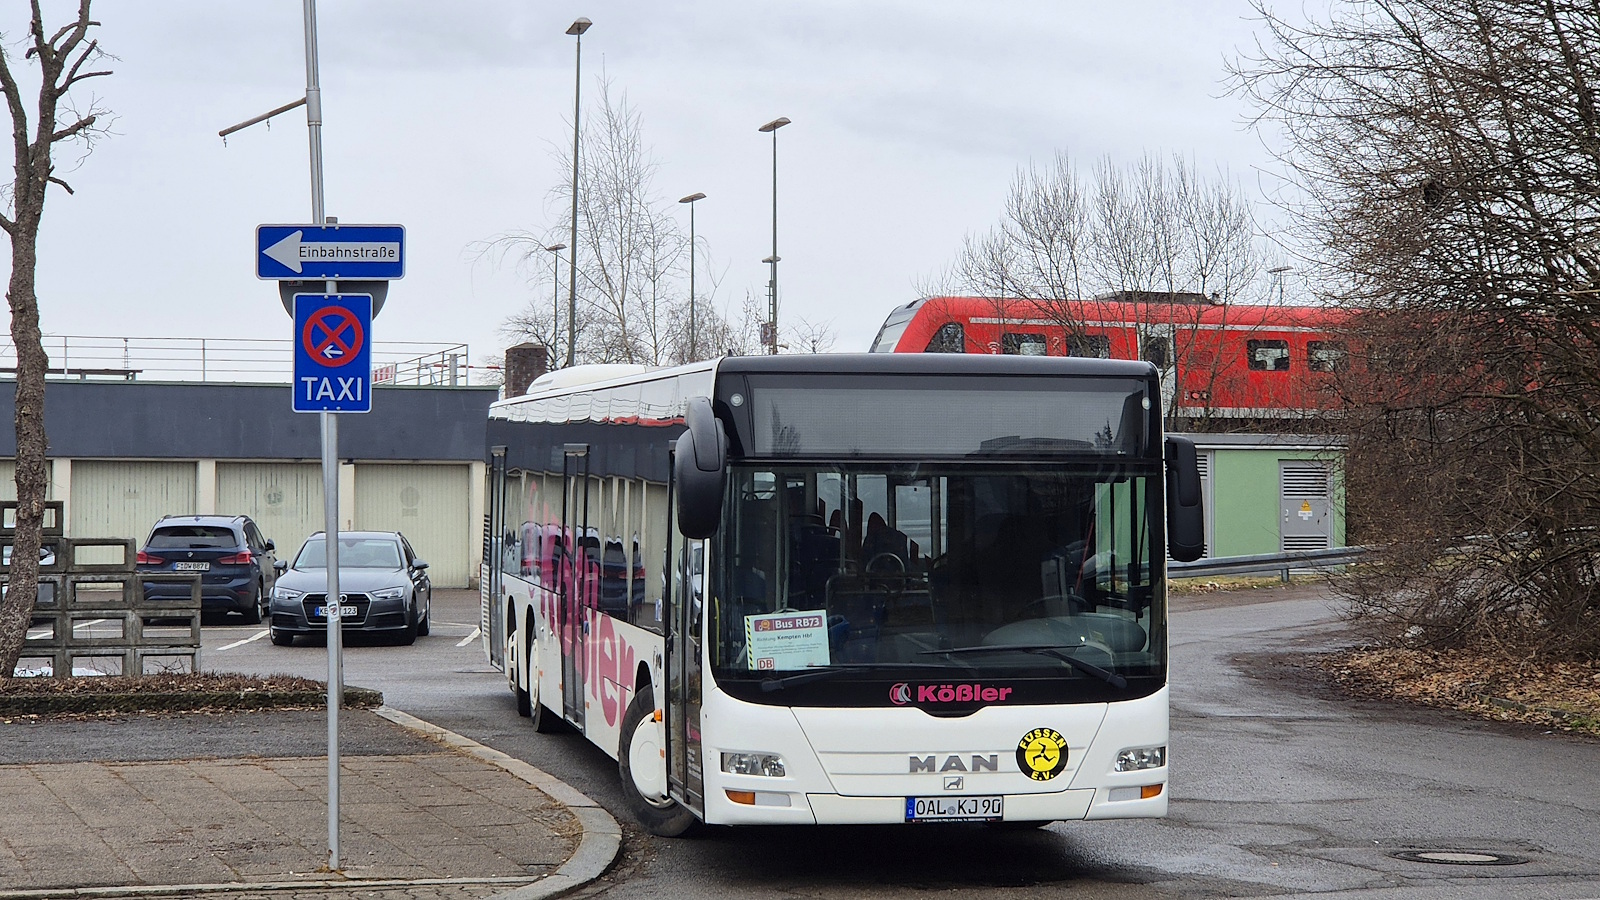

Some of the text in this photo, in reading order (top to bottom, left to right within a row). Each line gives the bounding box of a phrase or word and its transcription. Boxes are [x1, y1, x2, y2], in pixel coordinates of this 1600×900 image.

[299, 246, 396, 259] Einbahnstraße
[301, 376, 362, 401] TAXI
[343, 607, 357, 615] 123
[775, 617, 820, 629] Bus RB73
[759, 659, 773, 669] DB
[918, 684, 1012, 702] Kößler
[909, 755, 998, 773] MAN
[1030, 771, 1054, 780] E.V.
[916, 800, 946, 815] OAL
[958, 800, 978, 814] KJ
[982, 799, 1001, 814] 90
